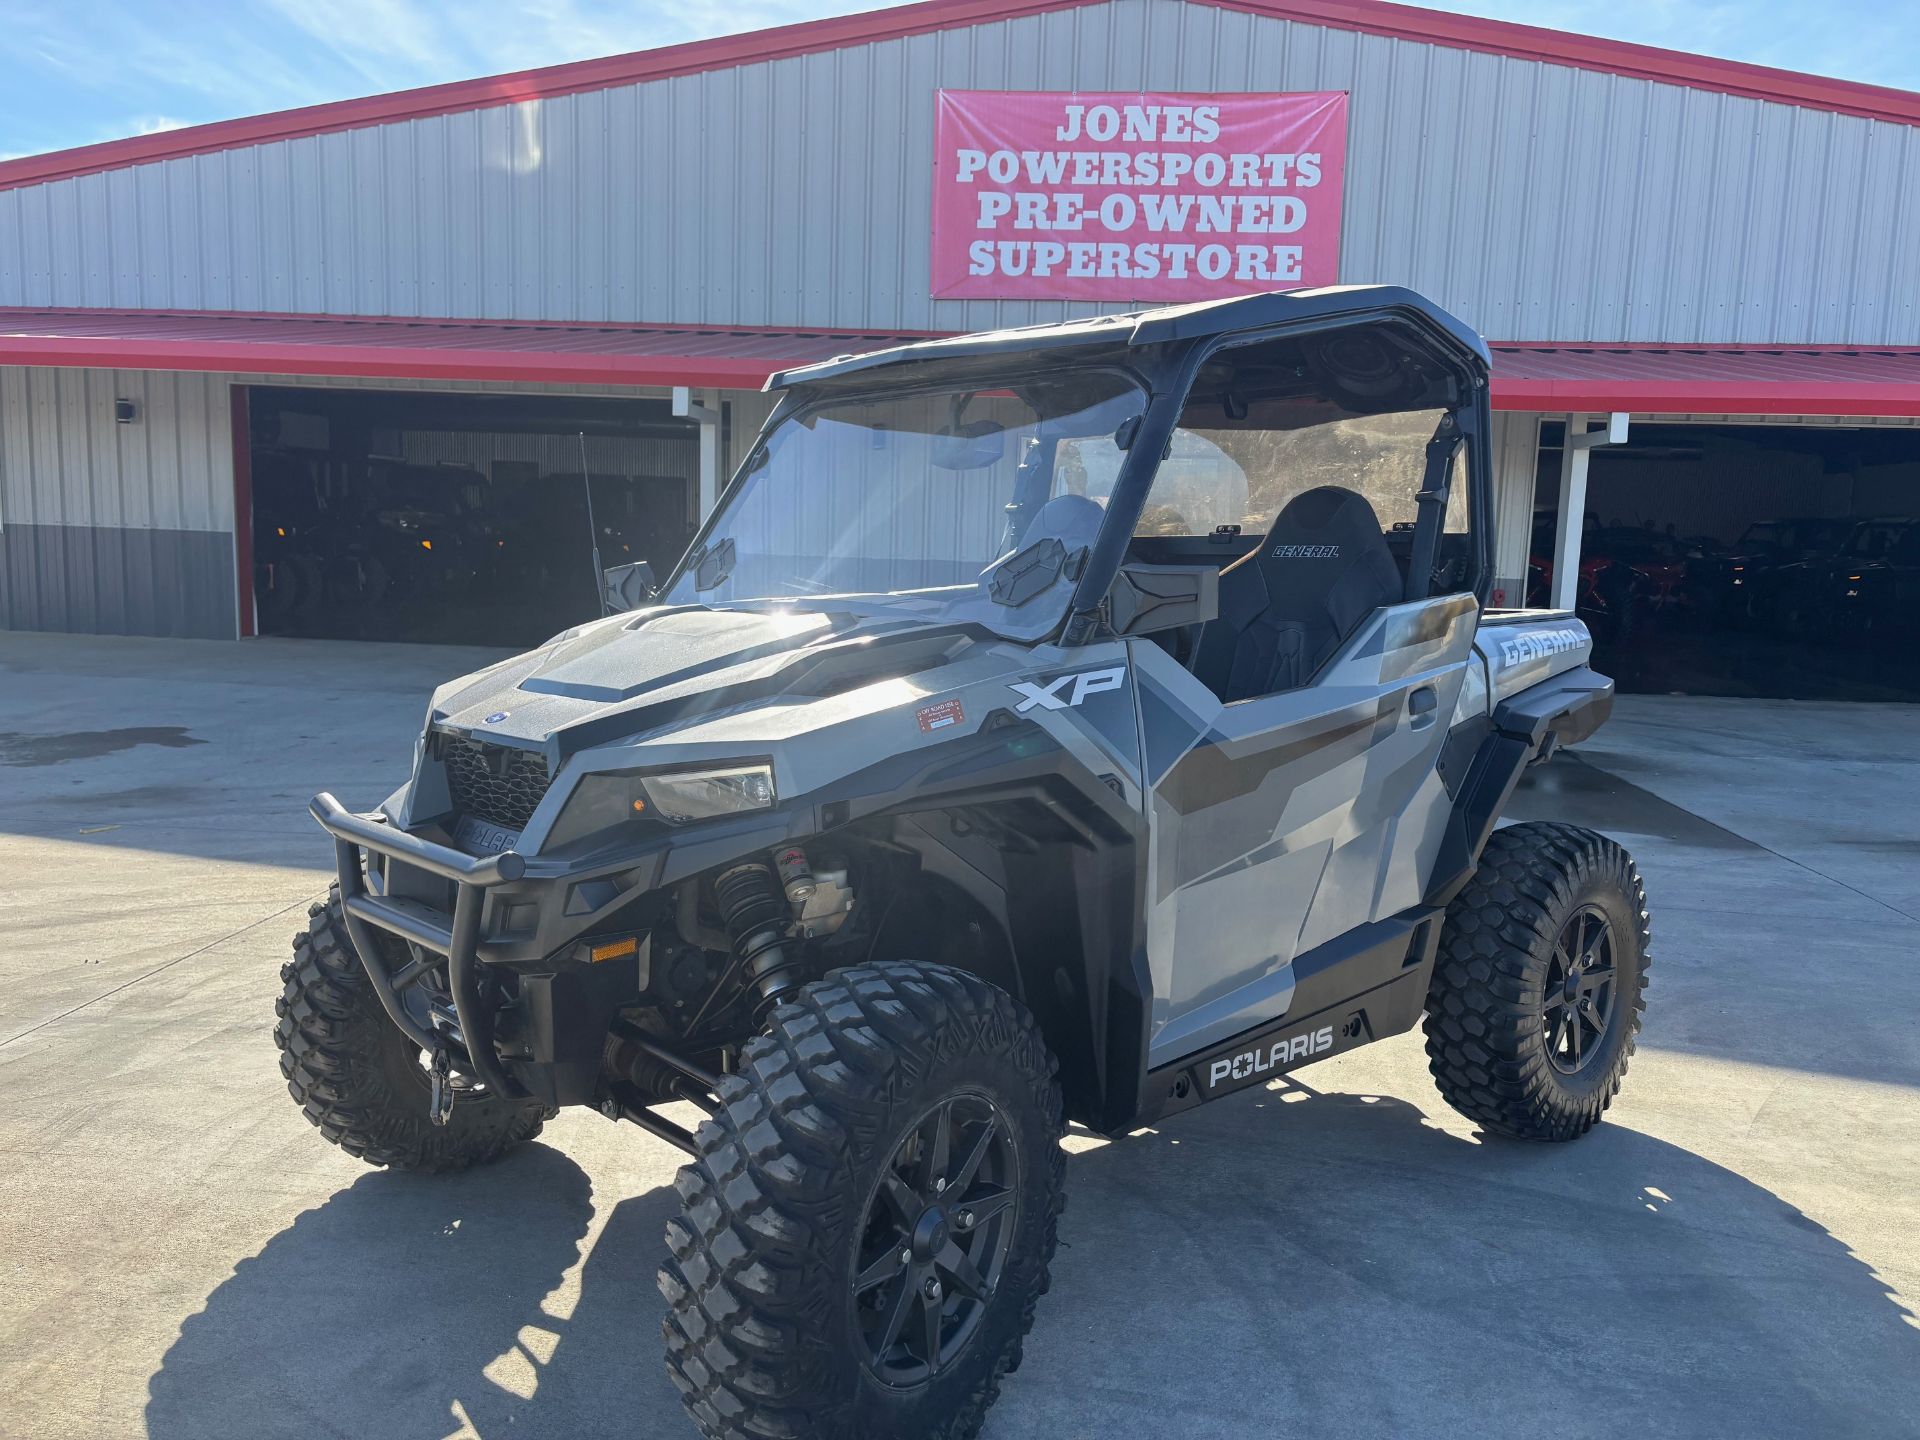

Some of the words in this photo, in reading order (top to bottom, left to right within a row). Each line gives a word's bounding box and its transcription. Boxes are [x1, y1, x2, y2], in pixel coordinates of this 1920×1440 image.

[1056, 105, 1221, 143] JONES
[955, 149, 1322, 187] POWERSPORTS
[976, 191, 1307, 233] PRE-OWNED
[968, 240, 1303, 281] SUPERSTORE
[1271, 545, 1340, 558] GENERAL
[1500, 628, 1586, 668] GENERAL
[1007, 666, 1126, 713] XP
[1209, 1026, 1333, 1088] POLARIS
